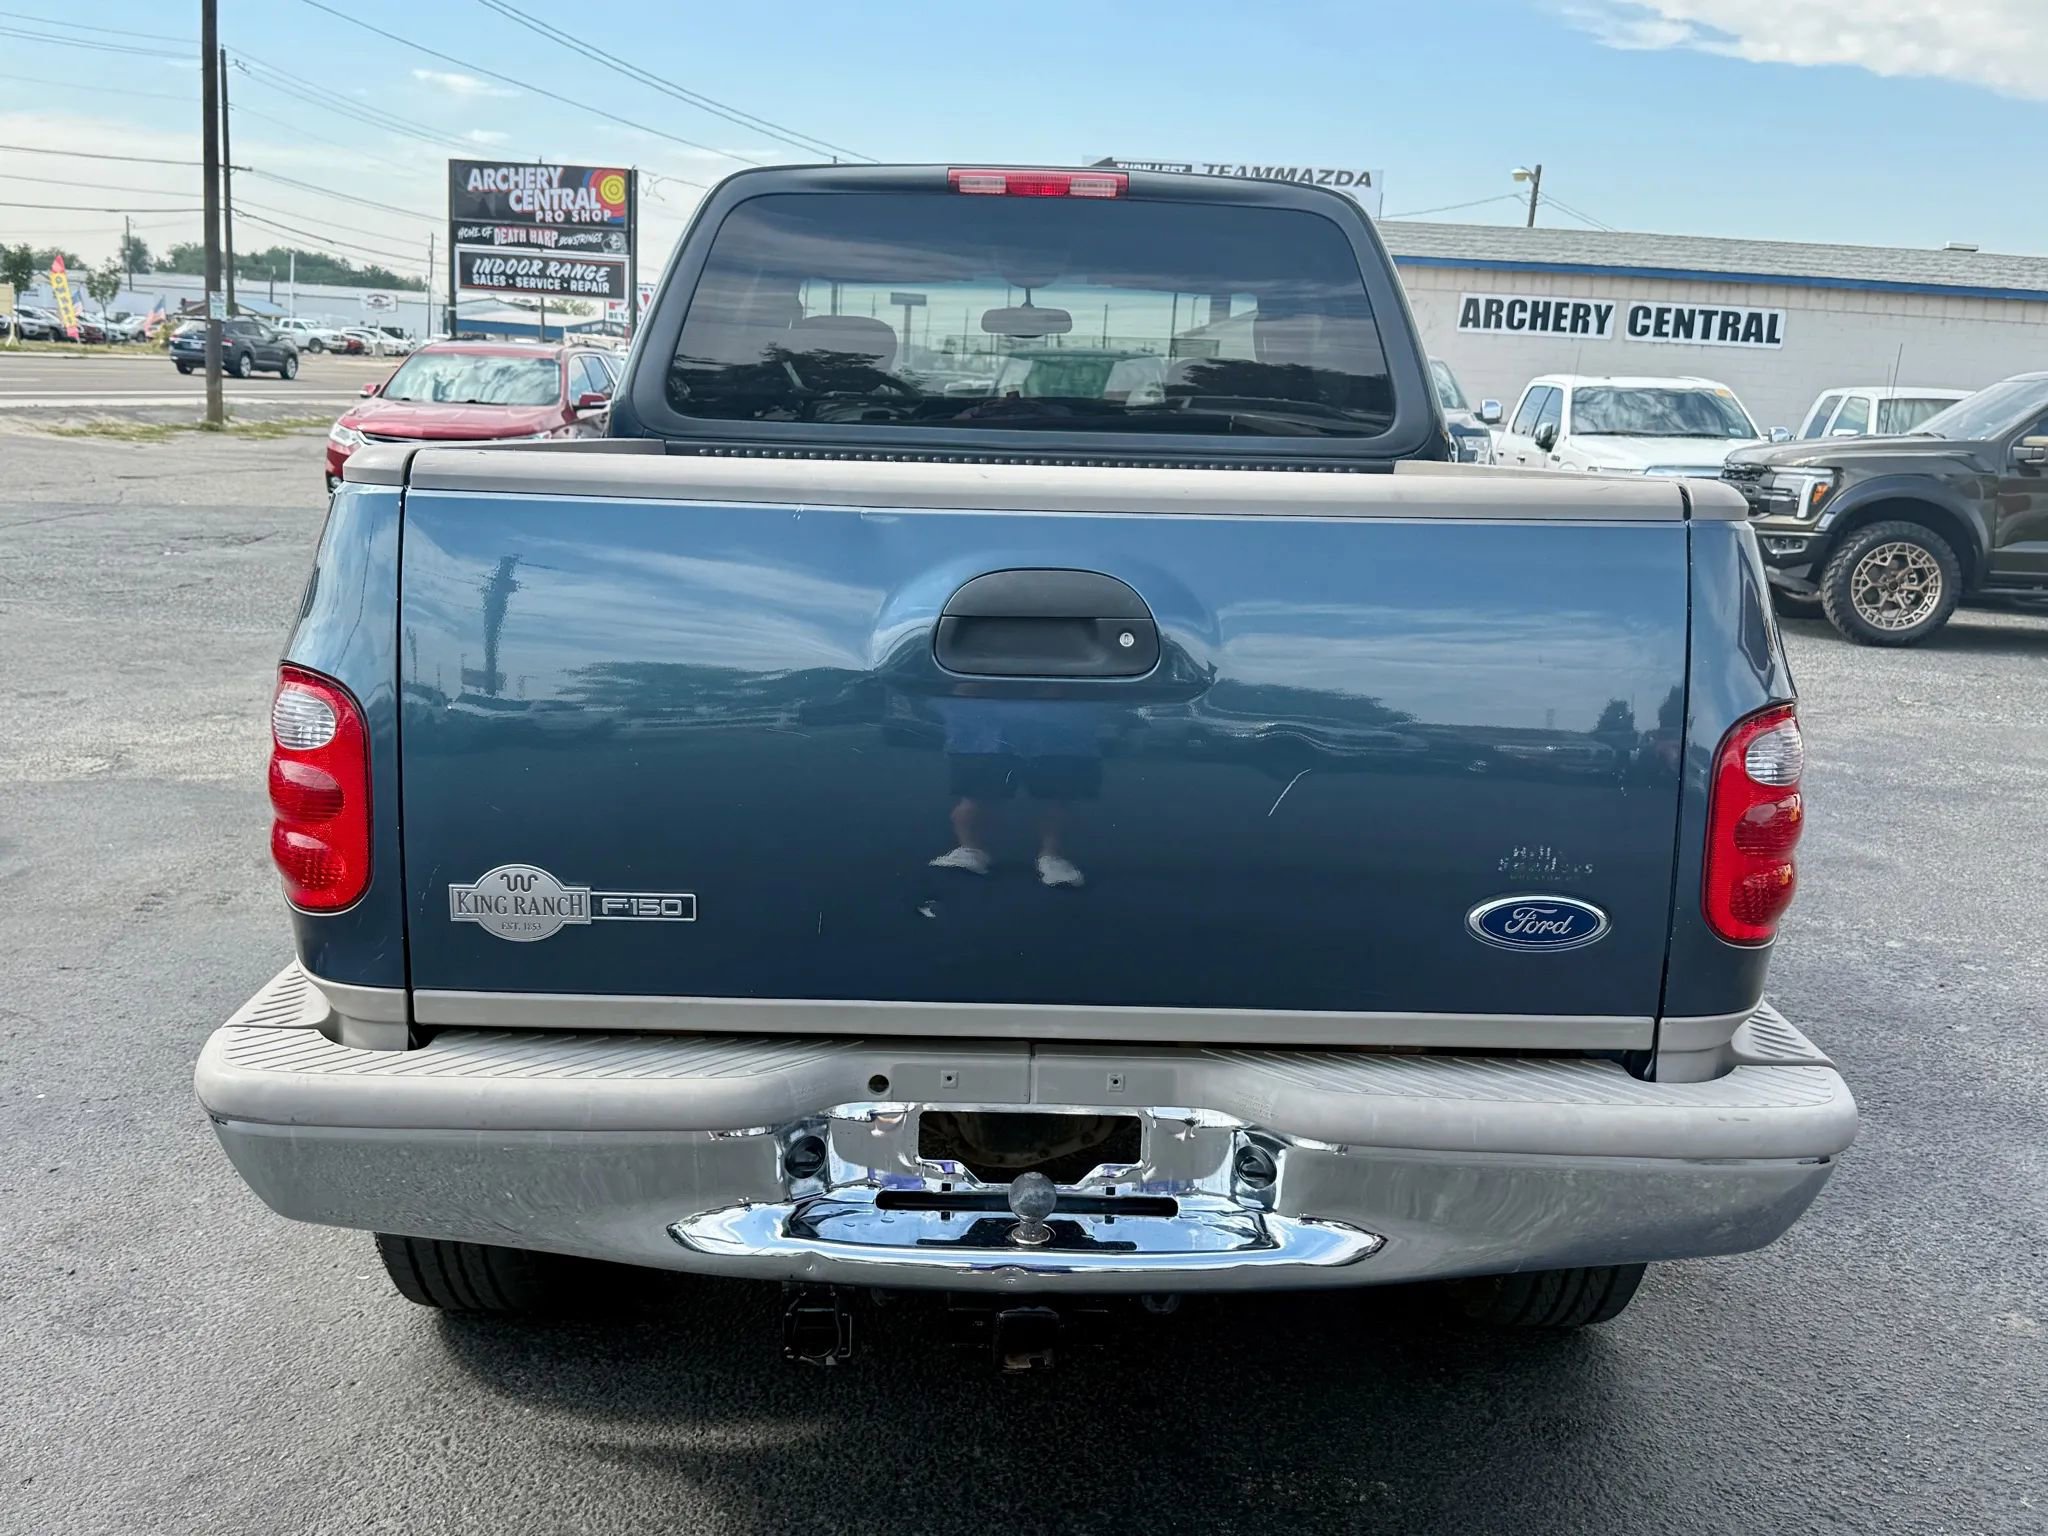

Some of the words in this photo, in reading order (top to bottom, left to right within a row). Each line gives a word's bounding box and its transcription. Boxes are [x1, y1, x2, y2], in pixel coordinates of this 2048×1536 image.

[467, 167, 564, 192] ARCHERY
[508, 187, 602, 213] CENTRAL
[535, 210, 565, 223] PRO
[571, 209, 612, 223] SHOP
[458, 226, 480, 240] HOME
[481, 226, 493, 239] OF
[494, 226, 527, 245] DEATH
[528, 228, 559, 249] HARP
[558, 232, 603, 247] BOWSTRINGS
[472, 258, 544, 276] INDOOR
[546, 261, 611, 282] RANGE
[472, 274, 507, 287] SALES
[515, 276, 561, 291] SERVICE
[570, 280, 610, 294] REPAIR
[1459, 297, 1614, 336] ARCHERY
[1627, 305, 1782, 345] CENTRAL
[456, 891, 508, 916] KING
[514, 893, 585, 918] RANCH
[601, 898, 683, 917] F-150
[1504, 907, 1575, 935] Ford
